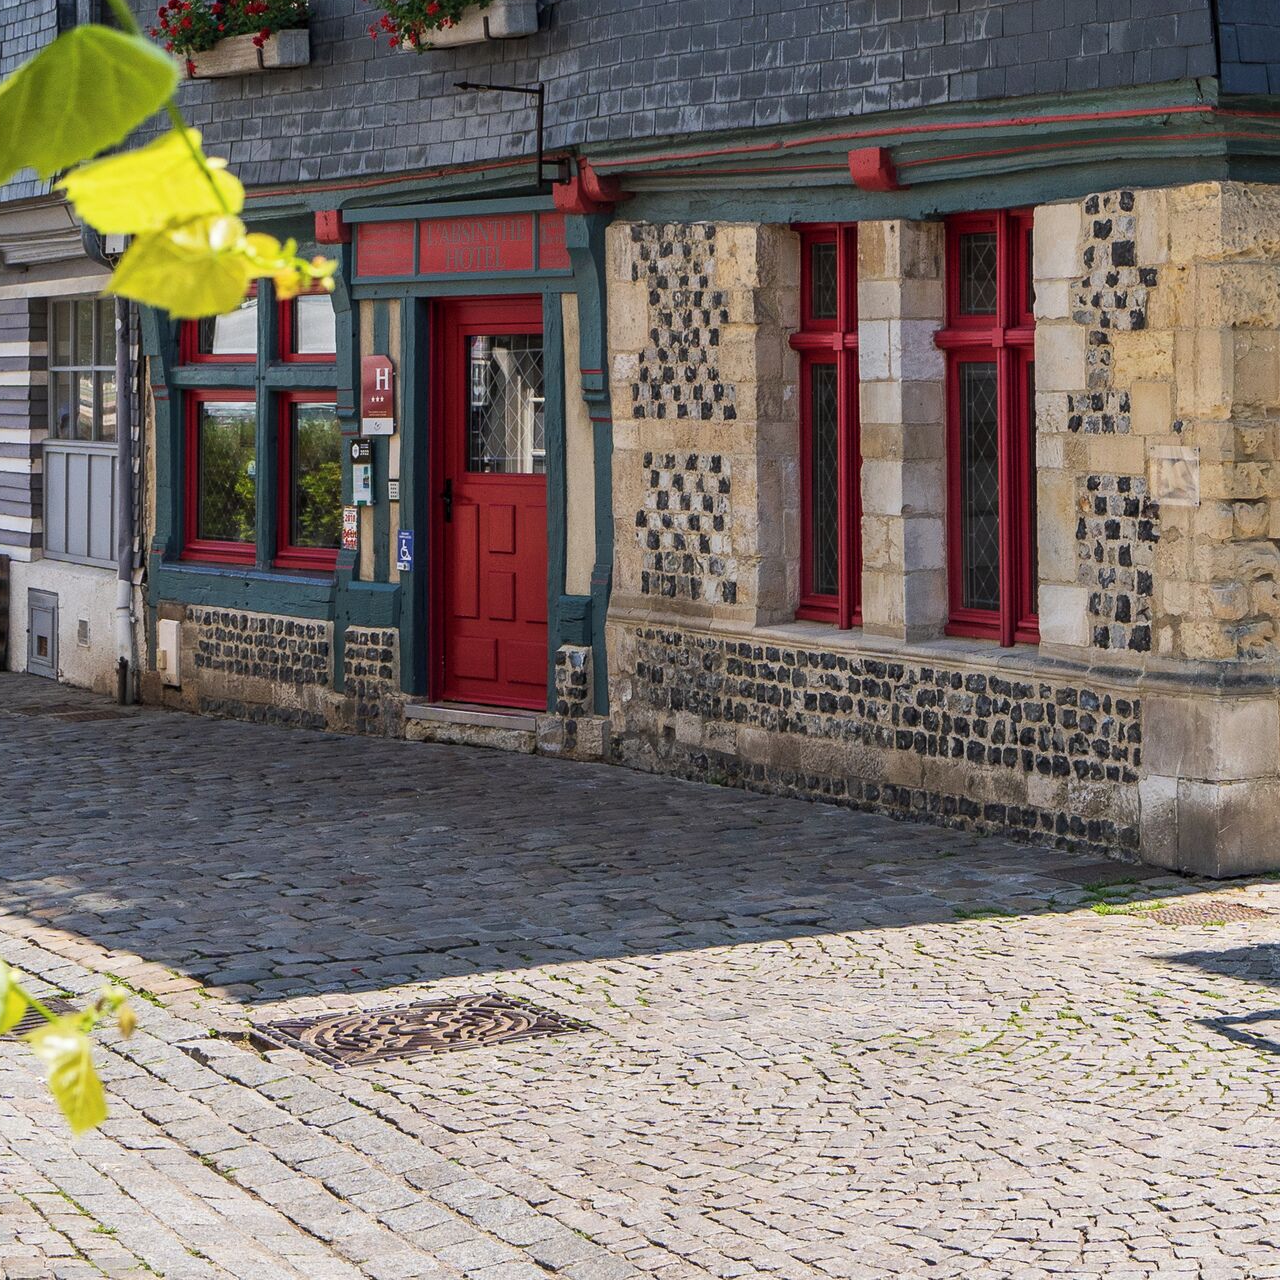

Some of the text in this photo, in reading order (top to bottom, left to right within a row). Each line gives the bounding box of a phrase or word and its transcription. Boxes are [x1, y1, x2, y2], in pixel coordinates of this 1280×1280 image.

[426, 218, 528, 247] L'ABSINTHE
[445, 246, 504, 271] HOTEL
[375, 367, 390, 391] H
